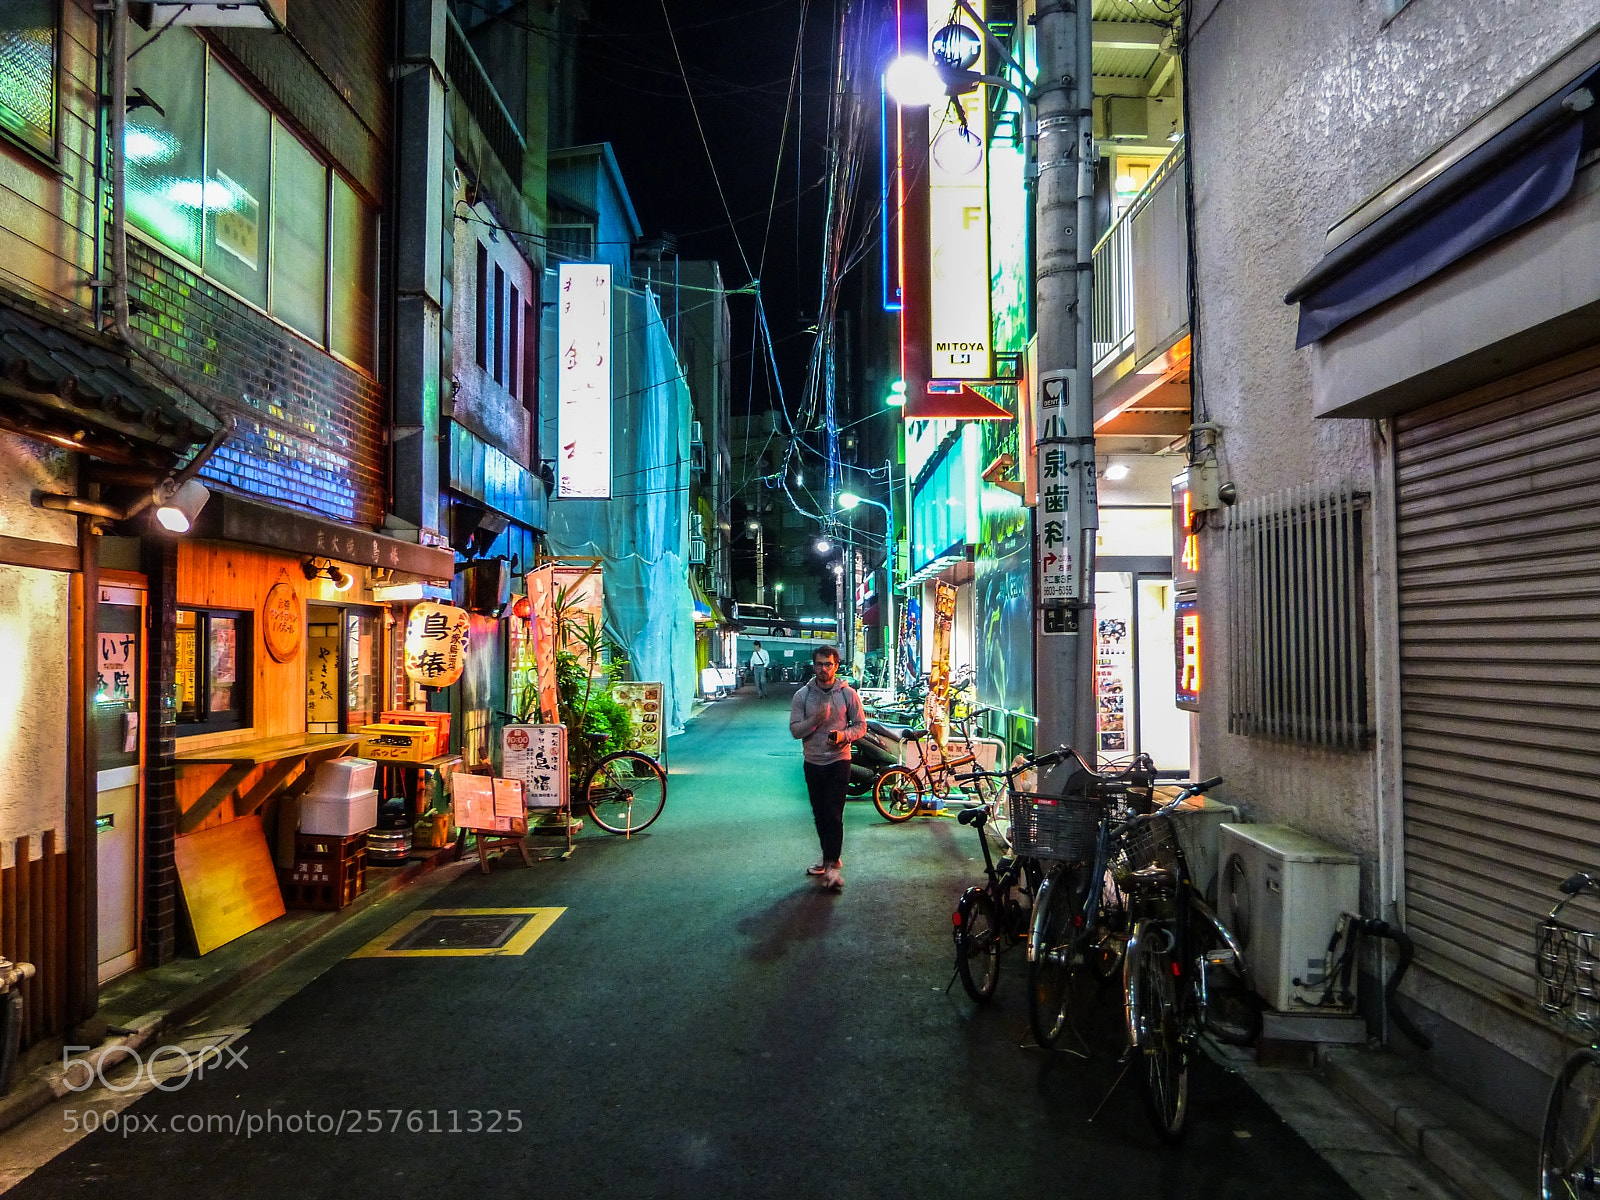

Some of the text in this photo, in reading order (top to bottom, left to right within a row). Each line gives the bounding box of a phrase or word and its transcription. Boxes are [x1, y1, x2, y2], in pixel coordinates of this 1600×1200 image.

[936, 342, 985, 351] MITOYA
[1044, 414, 1070, 549] 小泉歯科
[416, 611, 452, 679] 鳥椿
[370, 748, 409, 758] ホッピー
